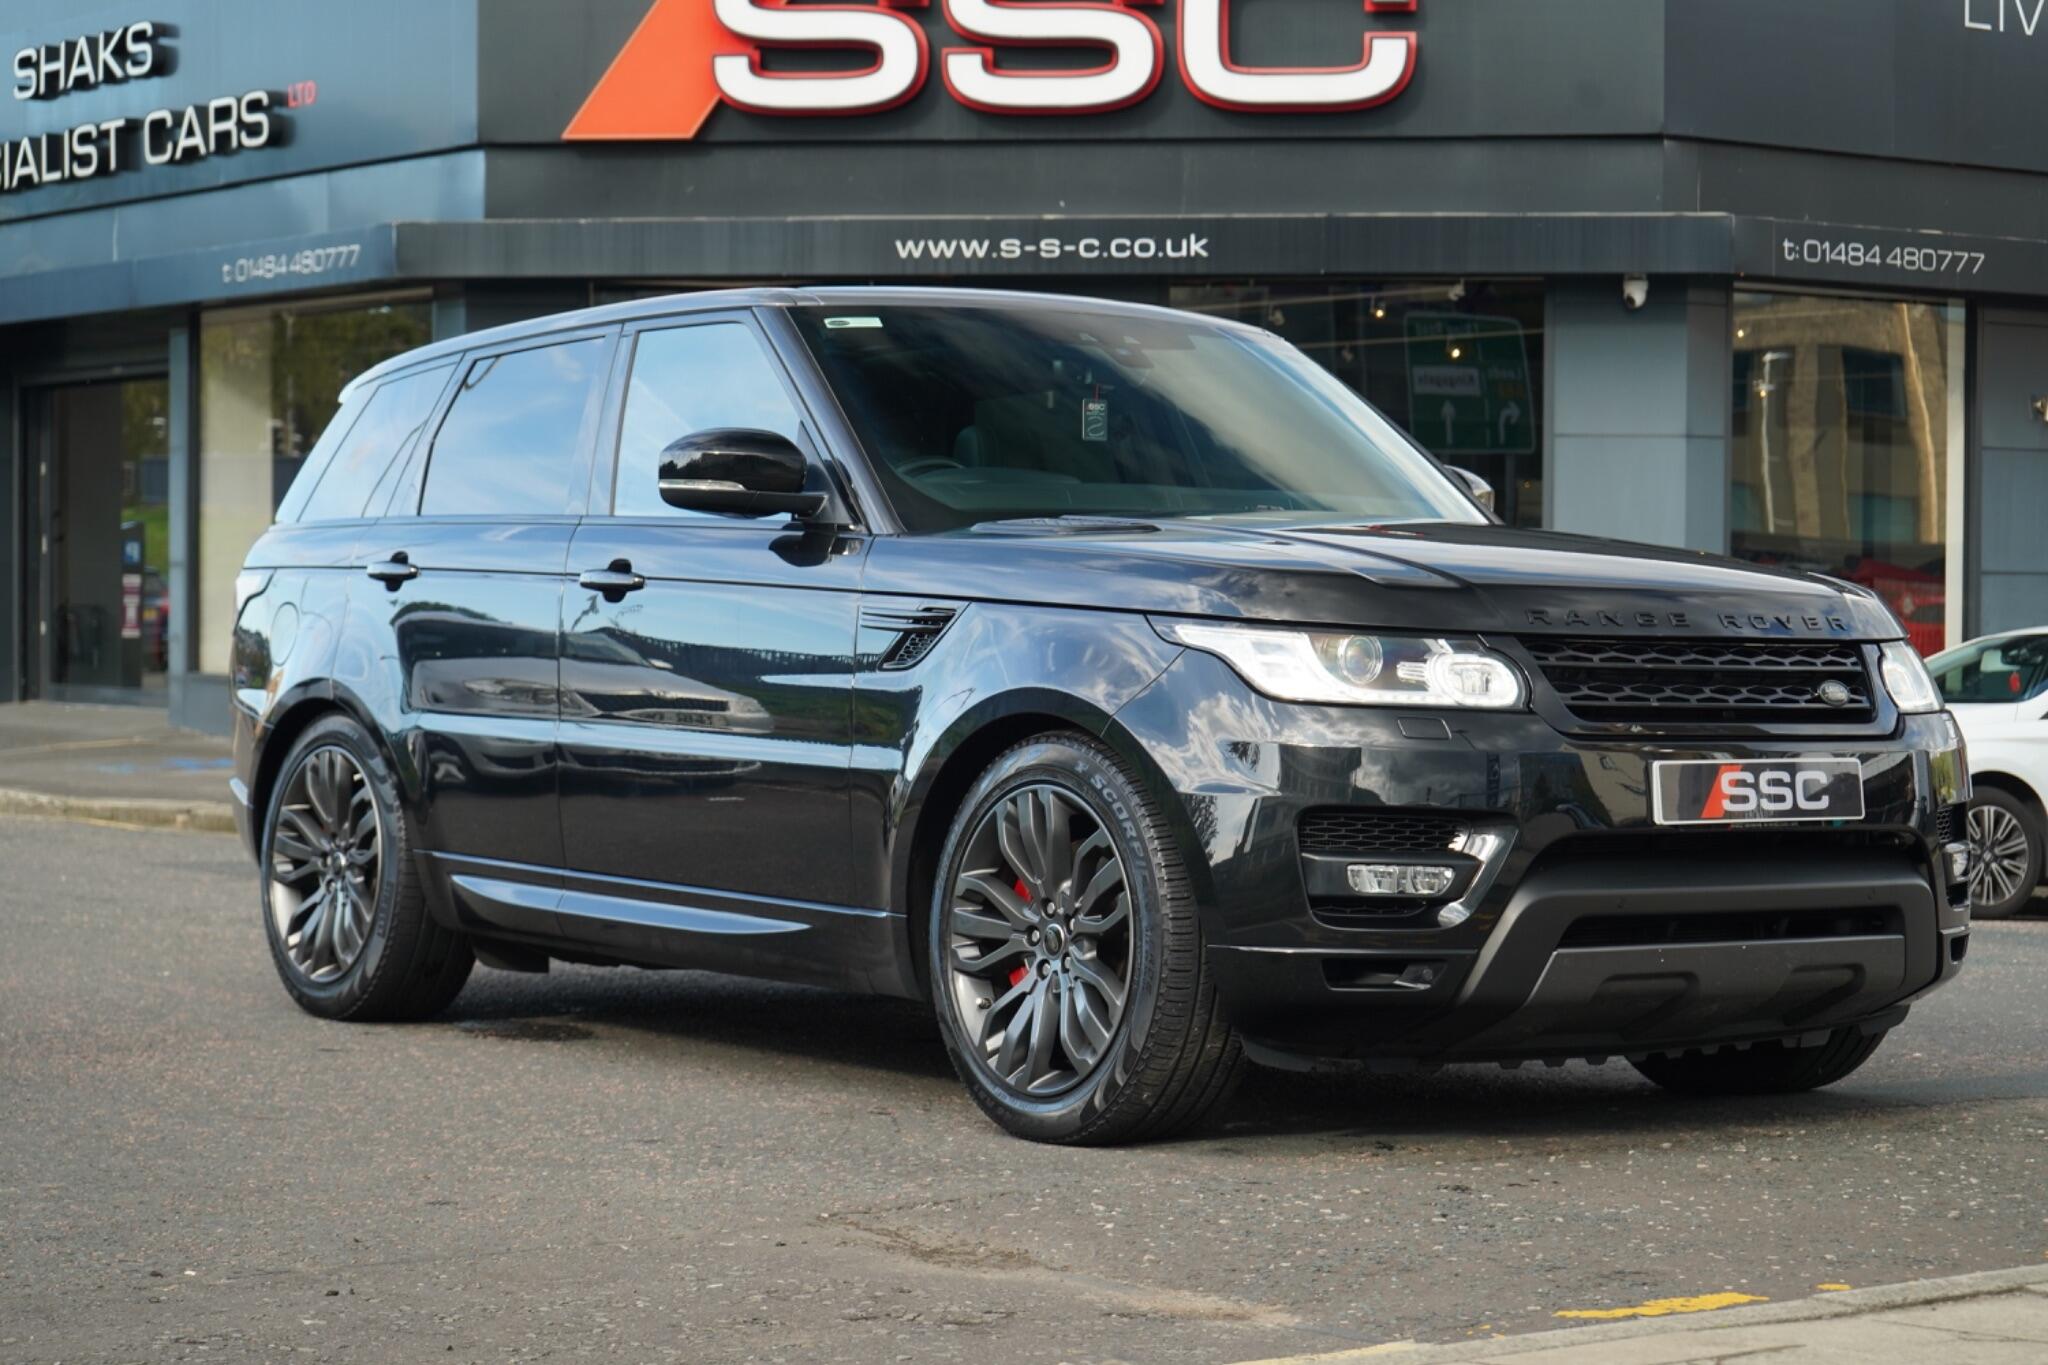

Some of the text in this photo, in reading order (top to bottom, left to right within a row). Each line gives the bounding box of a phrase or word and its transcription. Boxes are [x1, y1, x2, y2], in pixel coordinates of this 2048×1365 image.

[13, 20, 154, 100] SHAKS
[0, 80, 318, 191] IALIST CARS LTD
[895, 232, 1209, 260] www.s-s-c.co.uk
[1886, 246, 1985, 274] 480777
[1524, 609, 1849, 631] RANGE ROVER
[1721, 770, 1830, 812] SSC
